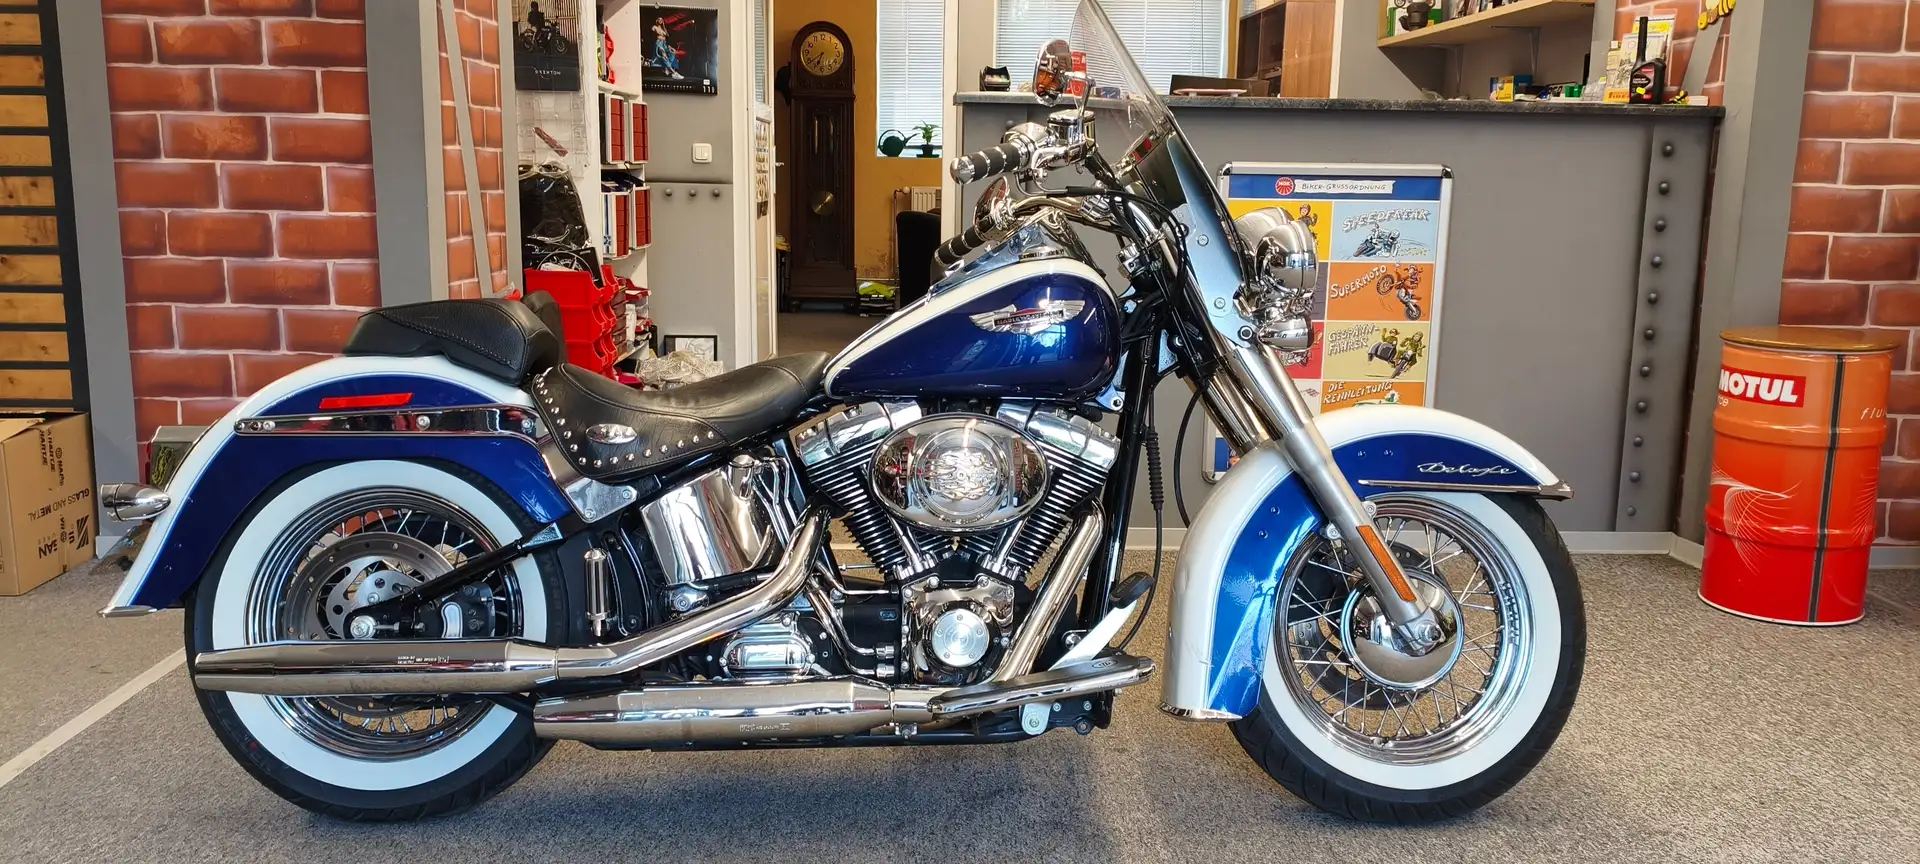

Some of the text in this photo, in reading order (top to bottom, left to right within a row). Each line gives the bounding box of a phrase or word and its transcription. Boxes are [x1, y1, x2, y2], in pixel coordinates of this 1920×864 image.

[1342, 208, 1431, 232] SPEEDFREAK
[1330, 264, 1387, 299] SUPERMOTO
[1719, 368, 1798, 403] MOTUL
[1417, 461, 1518, 477] Deluxe
[28, 488, 90, 522] GLASS AND METAL
